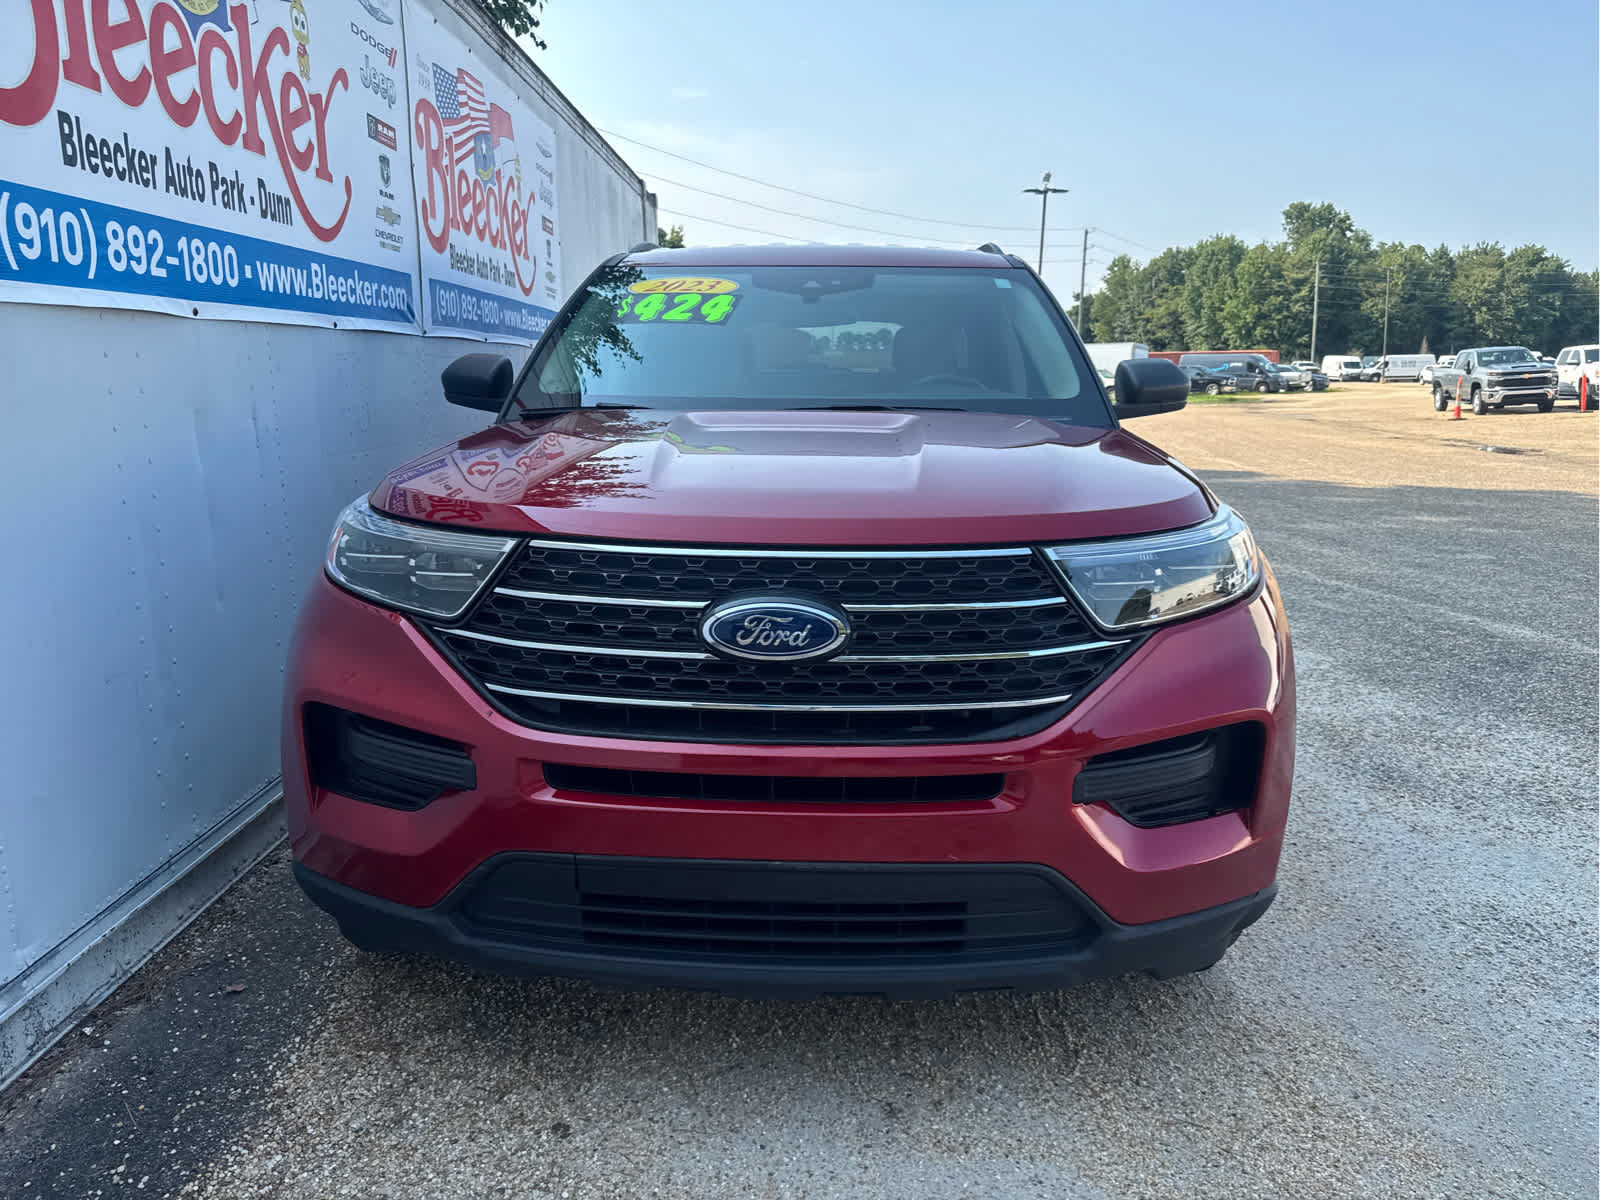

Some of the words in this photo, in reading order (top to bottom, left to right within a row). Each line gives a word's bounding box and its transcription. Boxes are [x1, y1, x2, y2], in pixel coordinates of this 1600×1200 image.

[351, 21, 393, 59] DODGE
[359, 54, 397, 109] Jeep
[57, 109, 158, 190] Bleecker
[164, 146, 206, 203] Auto
[208, 160, 248, 214] Park
[257, 177, 294, 227] Dunn
[379, 189, 395, 200] RAM
[415, 98, 536, 297] Bleecker
[0, 191, 98, 280] (910)
[105, 220, 239, 288] 892-1800
[255, 260, 408, 311] www.Bleecker.com
[449, 242, 476, 276] Bleecker
[476, 252, 489, 281] Auto
[489, 256, 502, 285] Park
[436, 283, 460, 324] (910)
[461, 293, 499, 325] 892-1800
[642, 280, 723, 292] 2023
[617, 293, 736, 323] $424
[736, 614, 812, 646] Ford
